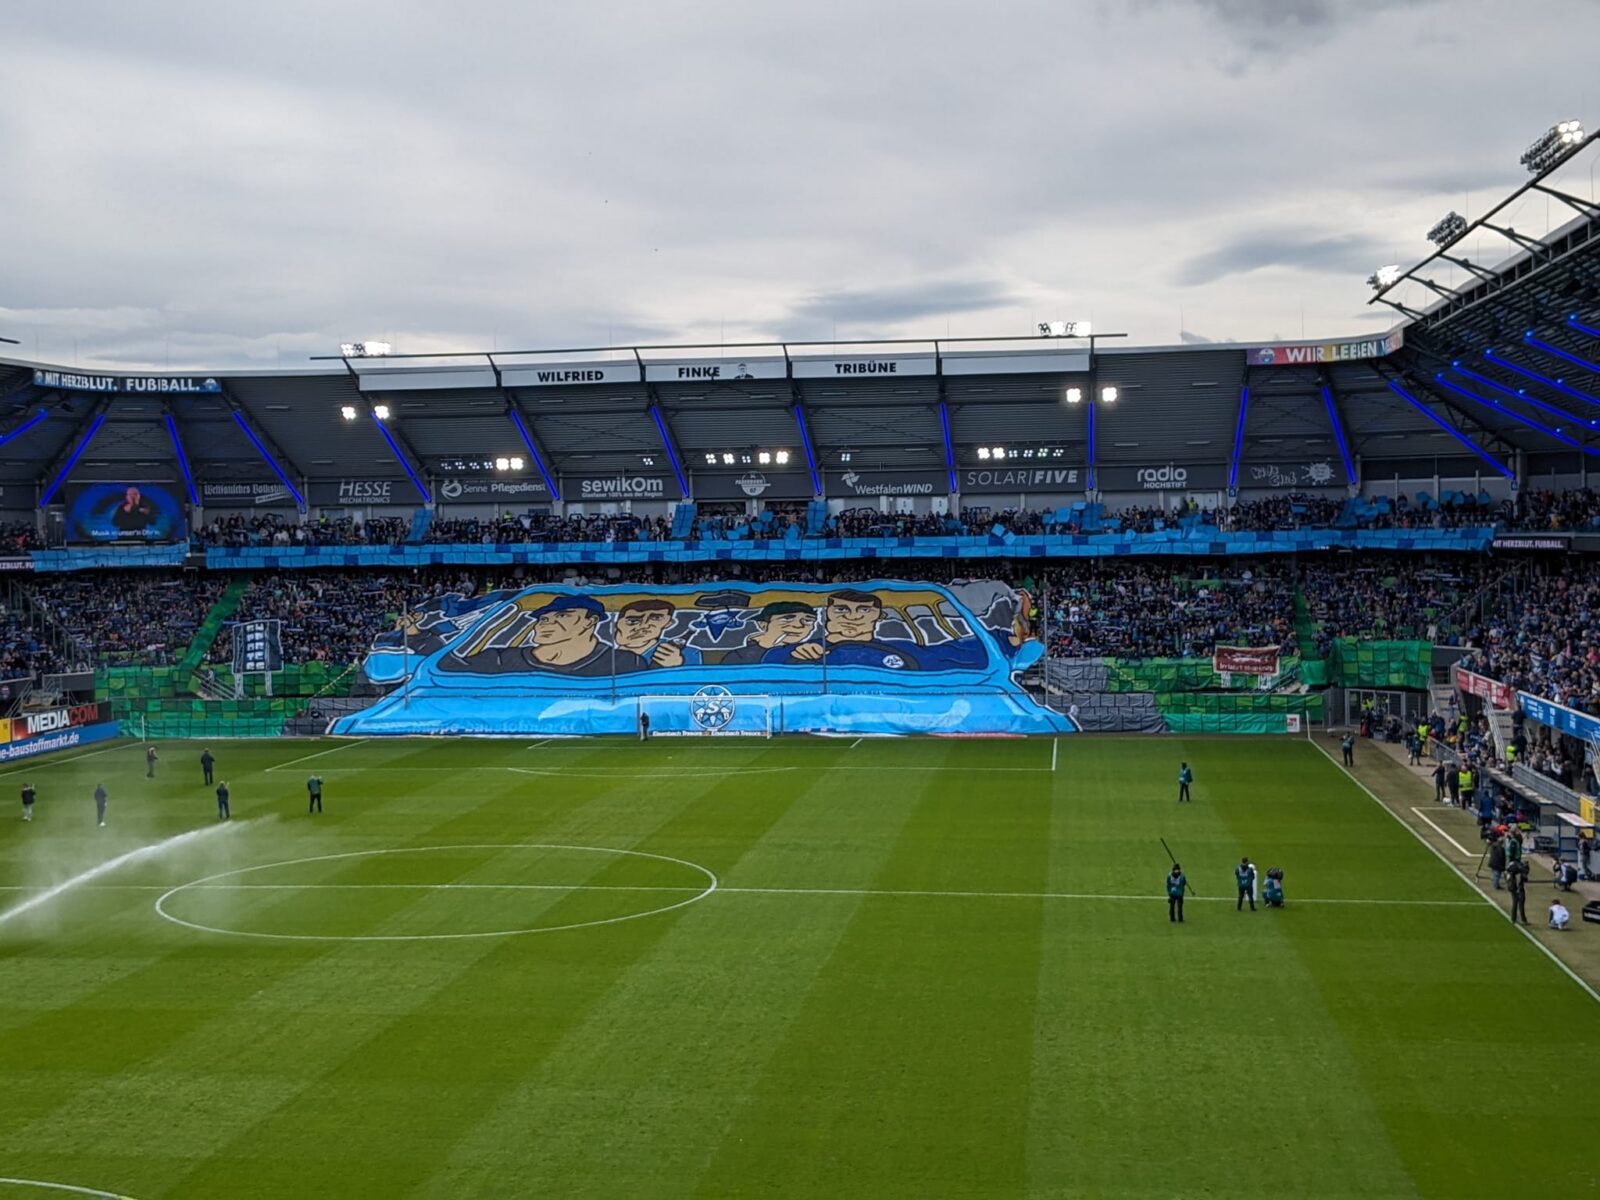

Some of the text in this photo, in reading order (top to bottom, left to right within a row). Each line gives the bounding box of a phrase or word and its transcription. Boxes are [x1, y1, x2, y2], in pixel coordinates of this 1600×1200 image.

[1286, 347, 1324, 362] WIR
[1332, 341, 1377, 360] LEBEN
[678, 366, 720, 378] FINKE
[835, 360, 896, 374] TRIBÜNE
[45, 372, 60, 386] MIT
[62, 374, 118, 391] HERZBLUT.
[538, 370, 604, 382] WILFRIED
[1137, 464, 1187, 482] radio
[339, 480, 392, 496] HESSE
[463, 484, 488, 492] Senne
[28, 704, 98, 734] MEDIACOM
[0, 732, 80, 759] e-baustoffmarkt.de
